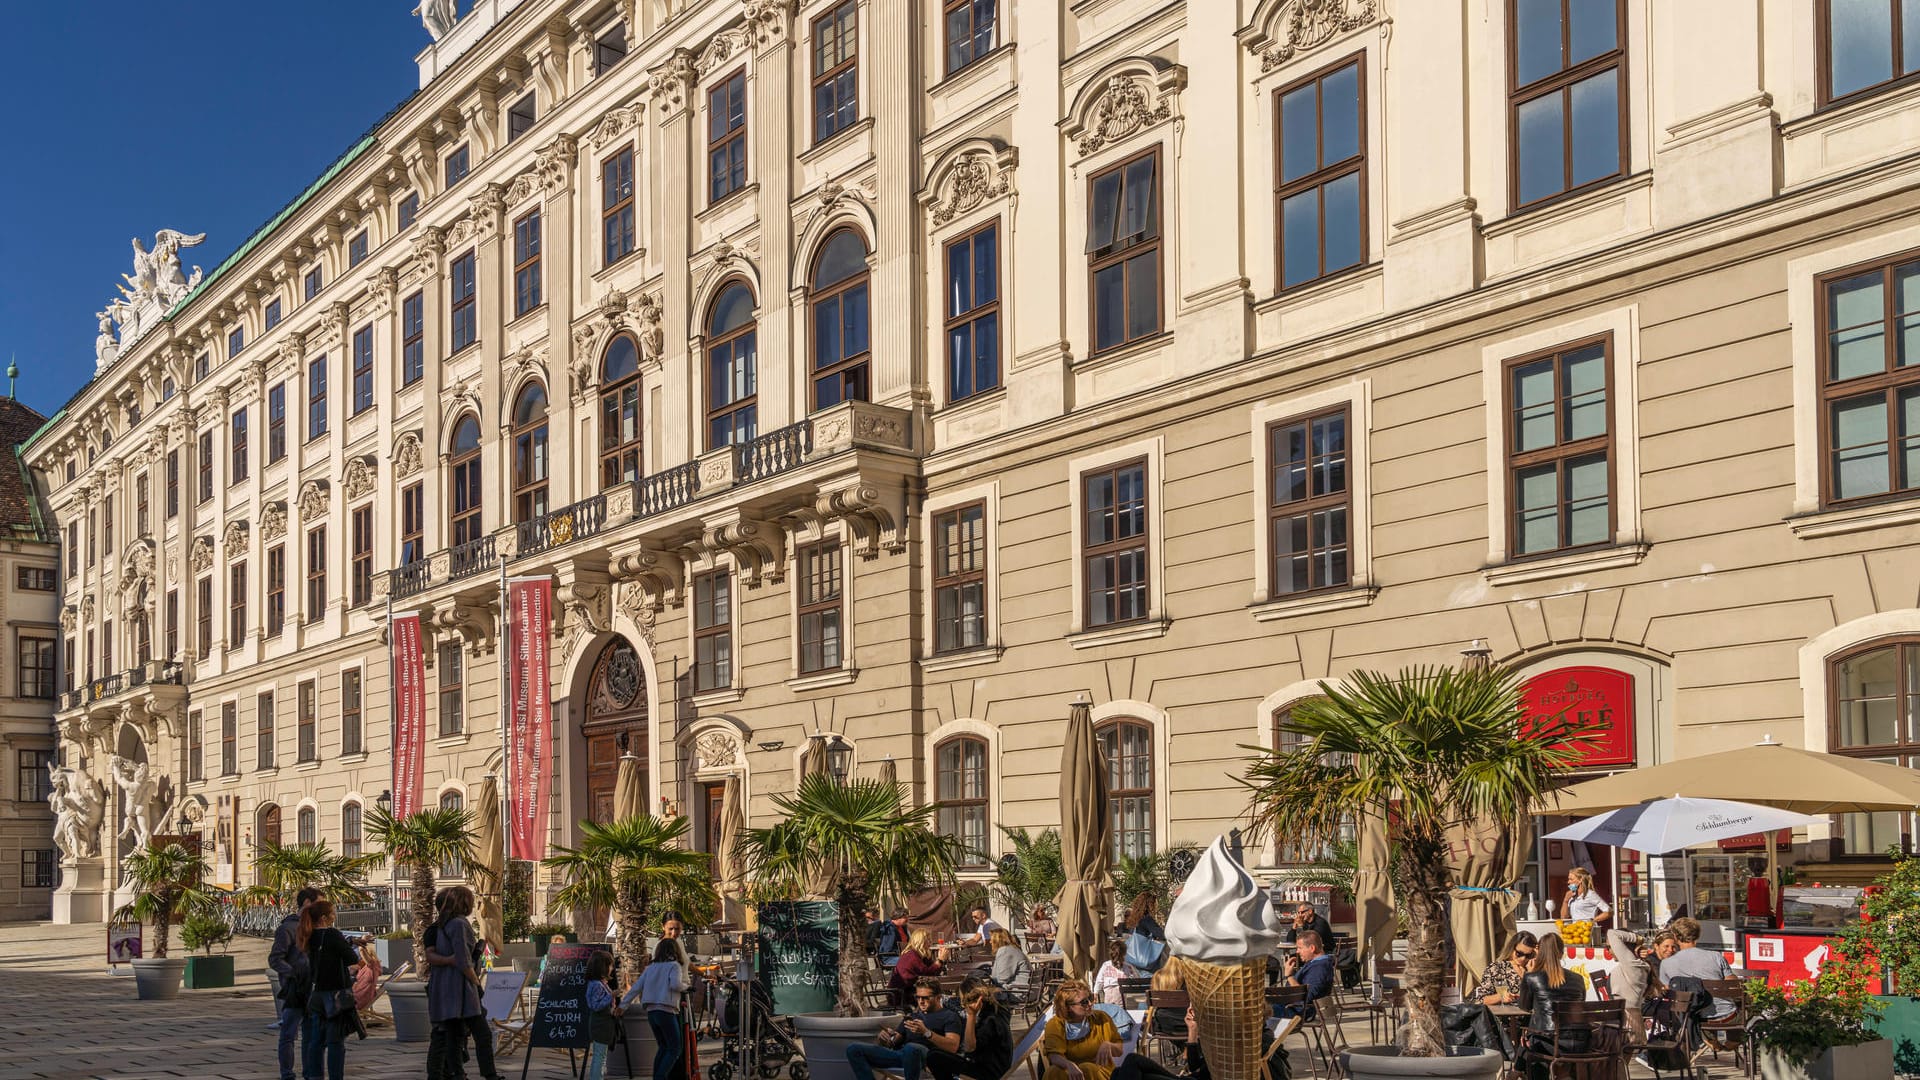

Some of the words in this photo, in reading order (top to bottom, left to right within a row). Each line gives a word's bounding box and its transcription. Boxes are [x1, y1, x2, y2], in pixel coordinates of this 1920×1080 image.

[519, 588, 530, 661] Silberkammer
[533, 588, 542, 633] Collection
[400, 622, 409, 687] Silberkammer
[408, 621, 417, 662] Collection
[535, 635, 543, 661] Silver
[517, 666, 529, 710] Museum
[535, 665, 543, 705] Museum
[1541, 690, 1606, 705] HOFBURG
[401, 692, 409, 732] Museum
[516, 713, 527, 732] Sisi
[535, 707, 543, 724] Sisi
[1532, 703, 1614, 734] CAFÉ
[399, 734, 408, 751] Sisi
[530, 727, 542, 780] Apartments
[406, 746, 416, 792] Apartments
[528, 781, 537, 818] Imperial
[1695, 814, 1753, 832] Schlumberger
[545, 1011, 582, 1023] STURM
